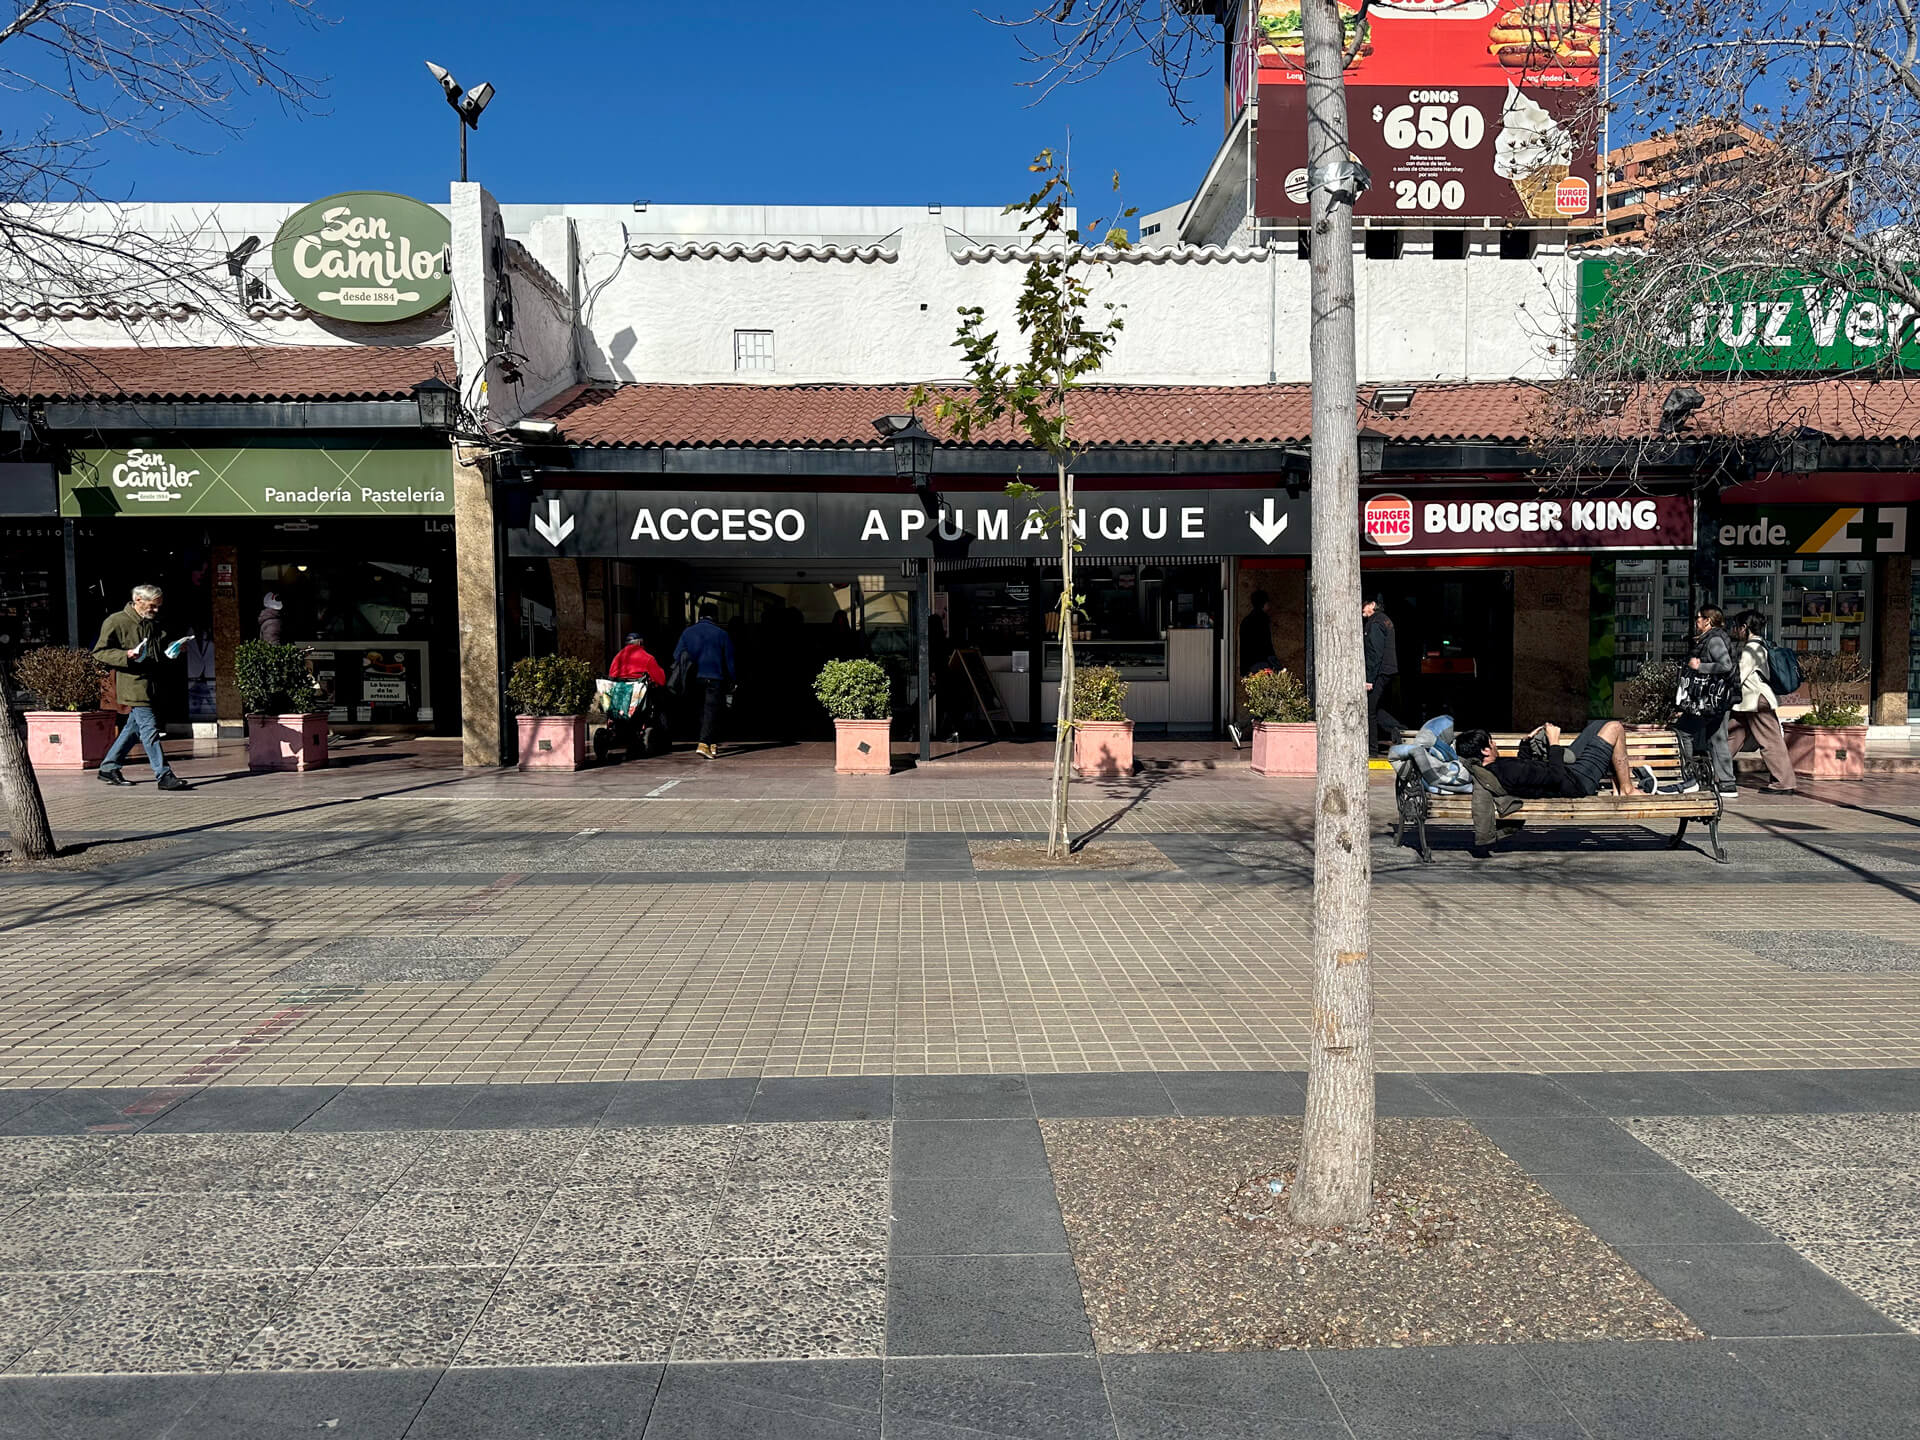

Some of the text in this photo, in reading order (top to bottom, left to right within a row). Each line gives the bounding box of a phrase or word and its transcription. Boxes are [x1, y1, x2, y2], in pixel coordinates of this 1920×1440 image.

[1409, 90, 1459, 103] CONOS
[1372, 104, 1485, 150] $650
[1557, 197, 1588, 206] KING
[320, 206, 391, 248] San
[293, 235, 444, 287] Camilo
[342, 291, 395, 302] desde 1884
[1801, 287, 1920, 348] Ver
[126, 448, 165, 470] San
[112, 463, 200, 491] Camilo
[265, 486, 445, 503] Panadería Pastelería
[630, 506, 1206, 542] ACCESO APUMANQUE
[1367, 509, 1411, 521] BURGER
[1424, 500, 1658, 533] BURGER KING
[6, 529, 94, 537] FESSIOAL
[1367, 520, 1411, 534] KING
[1719, 517, 1787, 546] erde
[1750, 560, 1772, 568] ISDIN
